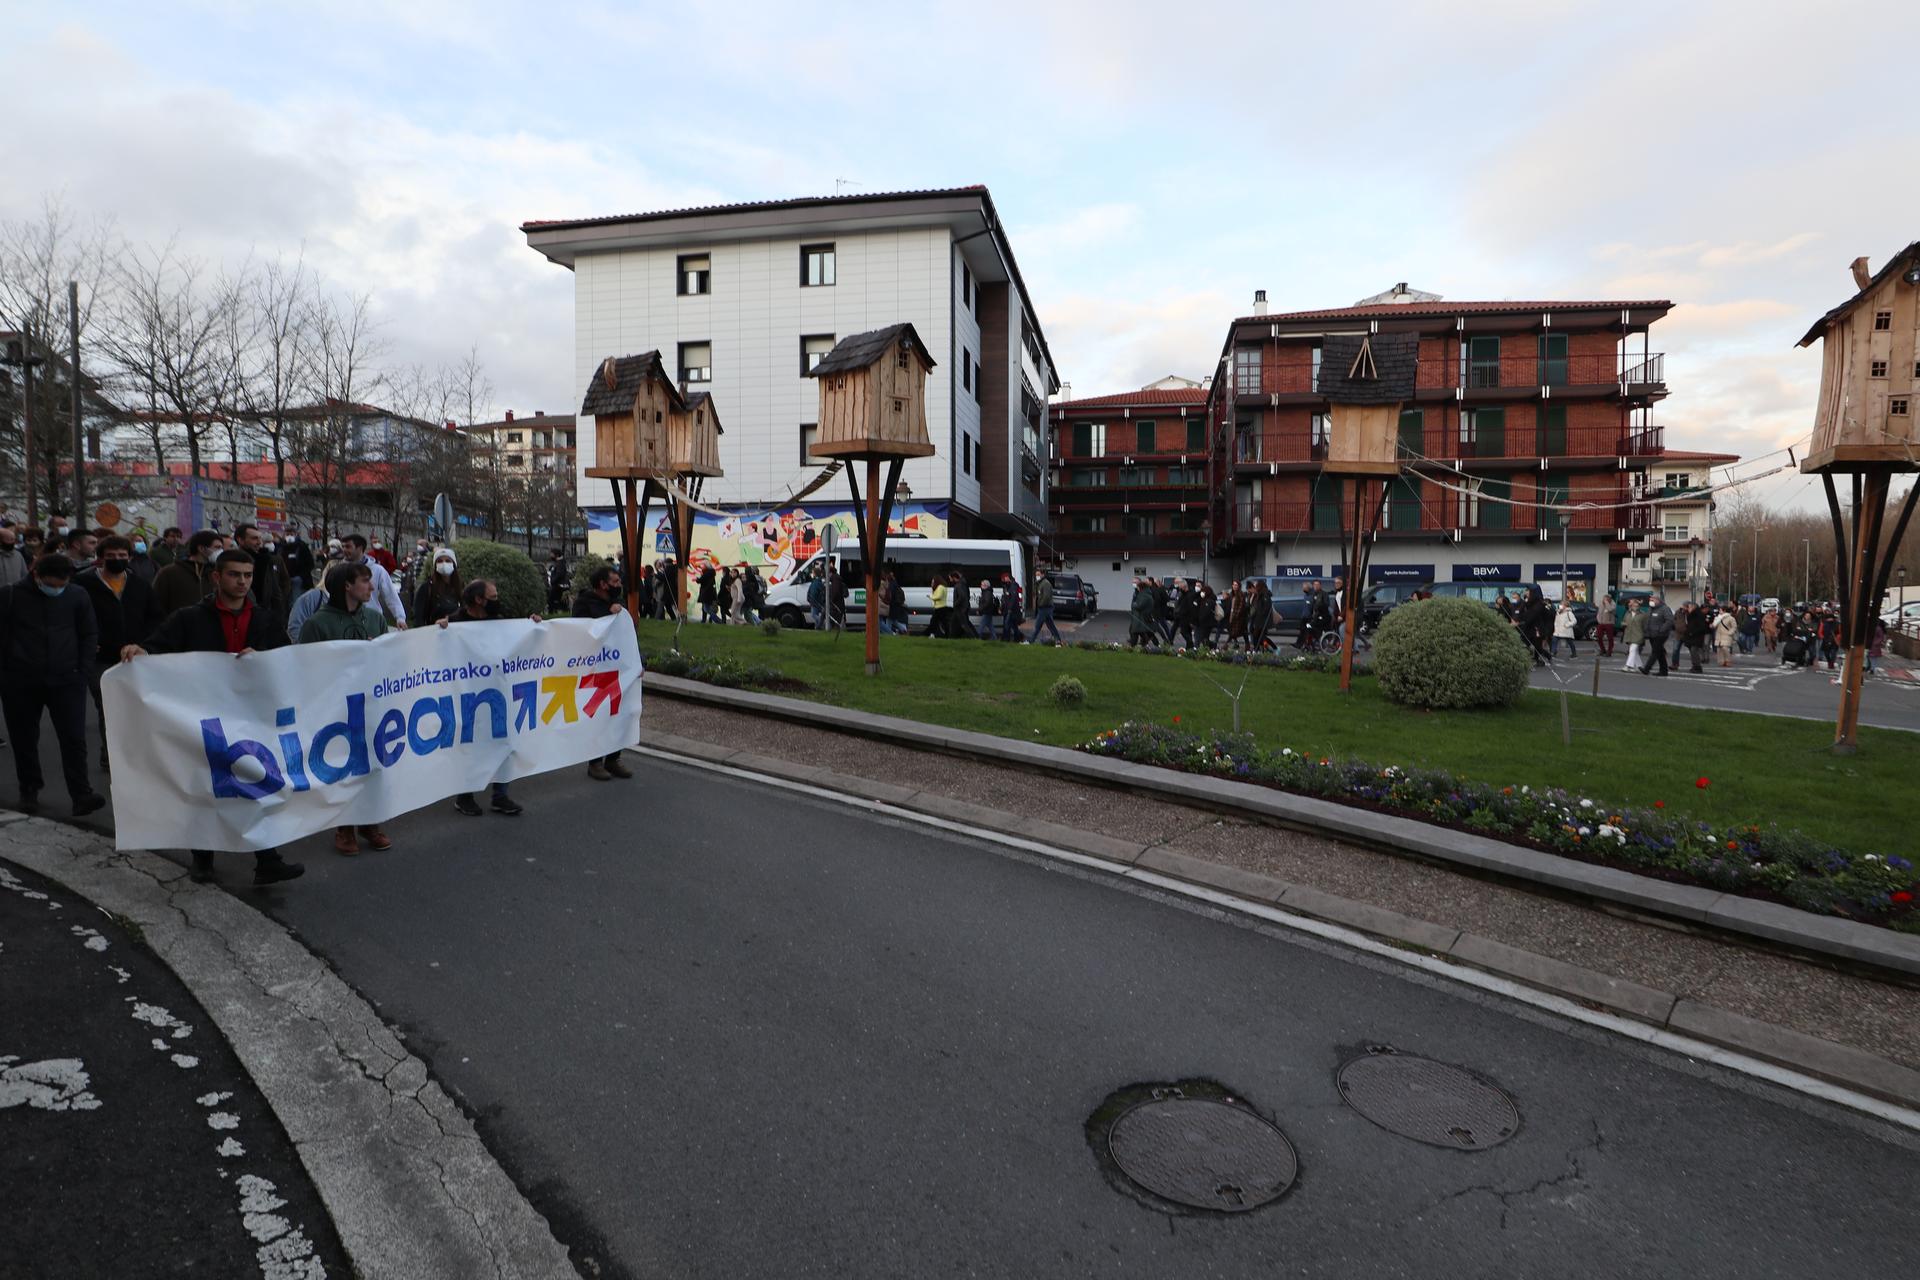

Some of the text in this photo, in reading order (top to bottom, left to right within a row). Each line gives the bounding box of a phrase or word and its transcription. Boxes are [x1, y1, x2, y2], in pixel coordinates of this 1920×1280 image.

[1286, 568, 1313, 577] BBVA
[1473, 567, 1500, 576] BBVA
[373, 662, 492, 699] elkarbizitzarako
[502, 654, 555, 674] bakerako
[200, 687, 507, 800] bidean
